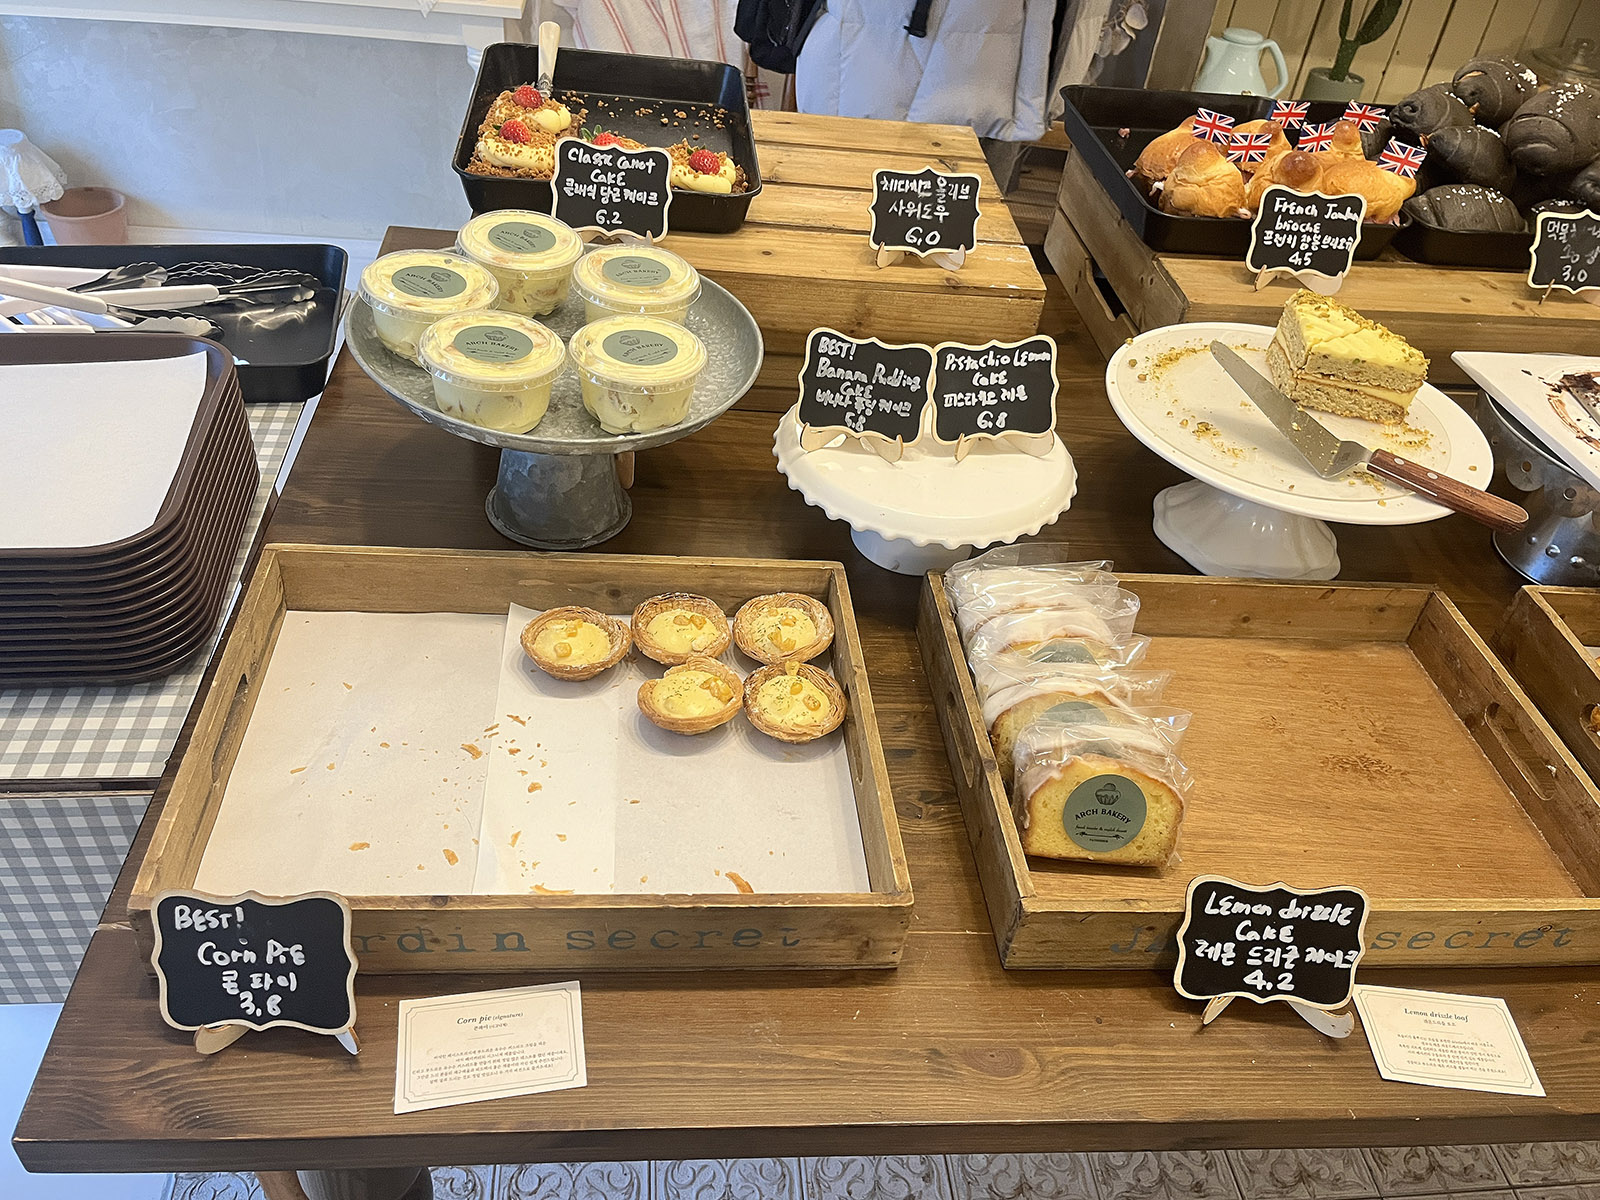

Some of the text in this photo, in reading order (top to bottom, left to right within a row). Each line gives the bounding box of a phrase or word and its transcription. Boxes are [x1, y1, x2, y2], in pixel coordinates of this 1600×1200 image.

[563, 178, 659, 206] 클래식 당근 케이크
[935, 176, 971, 203] 올리브
[595, 209, 623, 225] 6.2
[904, 226, 941, 246] 6.0
[1562, 265, 1588, 282] 3.0
[818, 336, 857, 361] BEST!
[976, 410, 1008, 429] 6.8
[1075, 808, 1131, 824] ARCH BAKERY
[174, 904, 245, 932] BEST!
[352, 926, 800, 953] rdin secret
[1370, 926, 1576, 950] secret
[197, 941, 257, 966] Corn
[1195, 939, 1236, 966] 레몬
[250, 972, 298, 992] 파이
[1243, 969, 1295, 991] 4.2
[239, 990, 282, 1017] 3.8
[479, 1014, 492, 1024] pie
[1404, 1008, 1469, 1023] Lemon drizzle loaf
